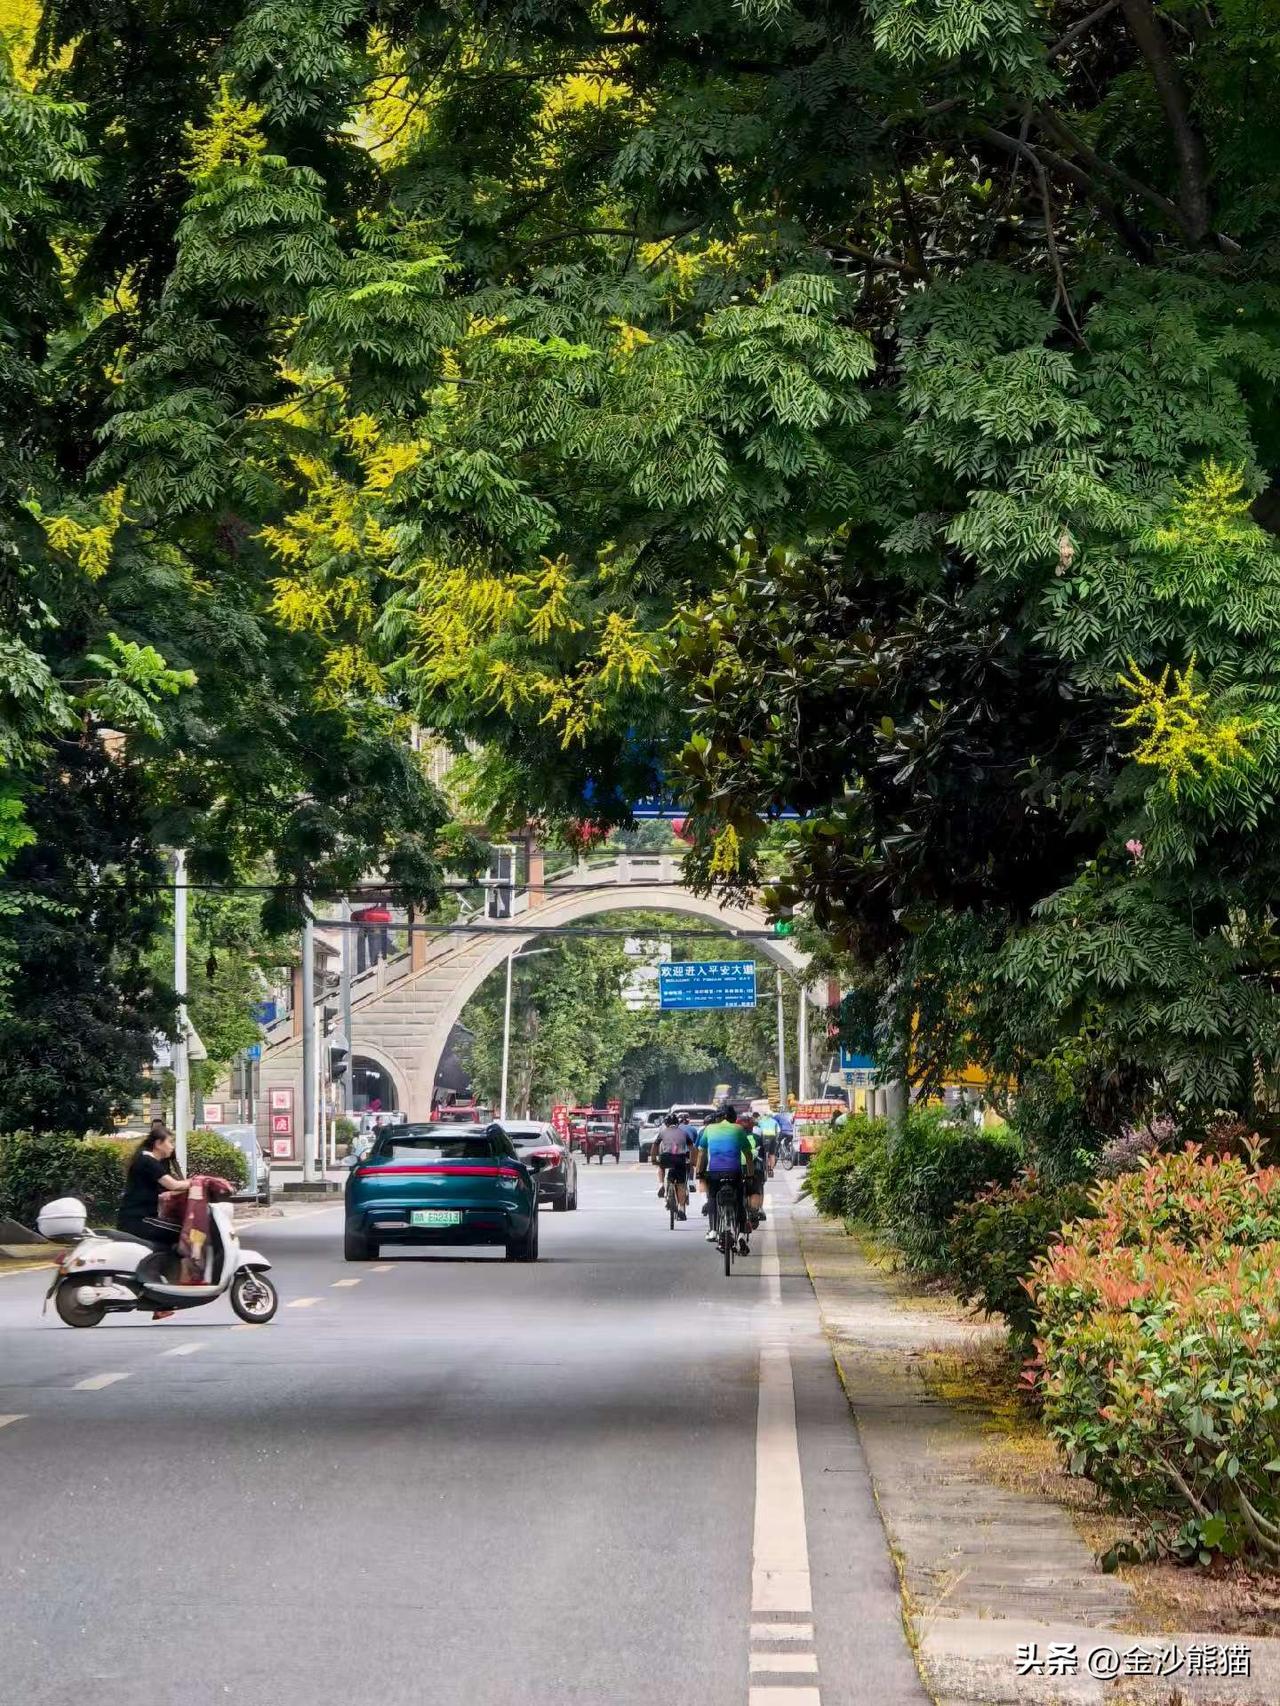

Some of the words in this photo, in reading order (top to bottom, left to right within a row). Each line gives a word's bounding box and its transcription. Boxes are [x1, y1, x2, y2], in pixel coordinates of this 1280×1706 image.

[661, 965, 754, 976] 欢迎进入平安大道
